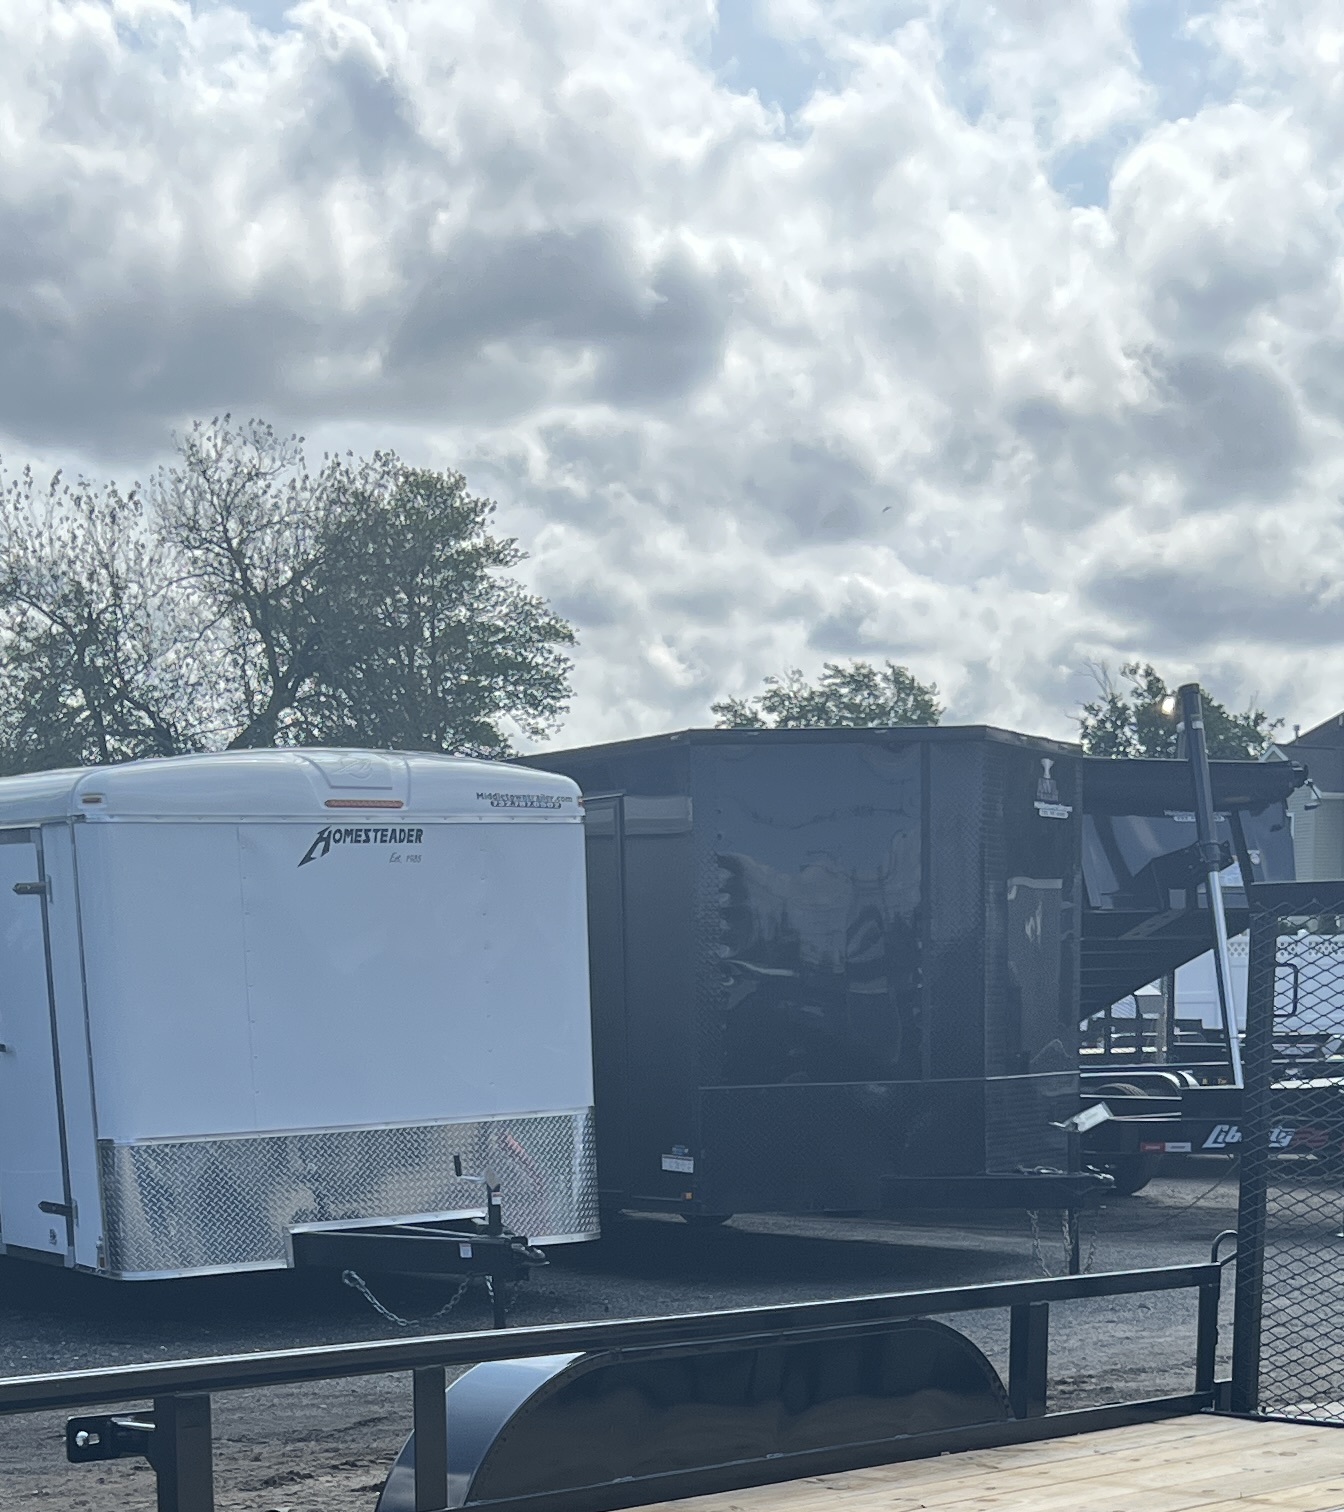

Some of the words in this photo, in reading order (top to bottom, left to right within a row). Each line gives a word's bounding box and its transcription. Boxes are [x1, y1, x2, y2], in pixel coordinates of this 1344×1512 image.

[475, 792, 573, 803] Middletowntrailer.com
[297, 825, 424, 868] HOMESTEADER
[1202, 1124, 1296, 1149] Libty
